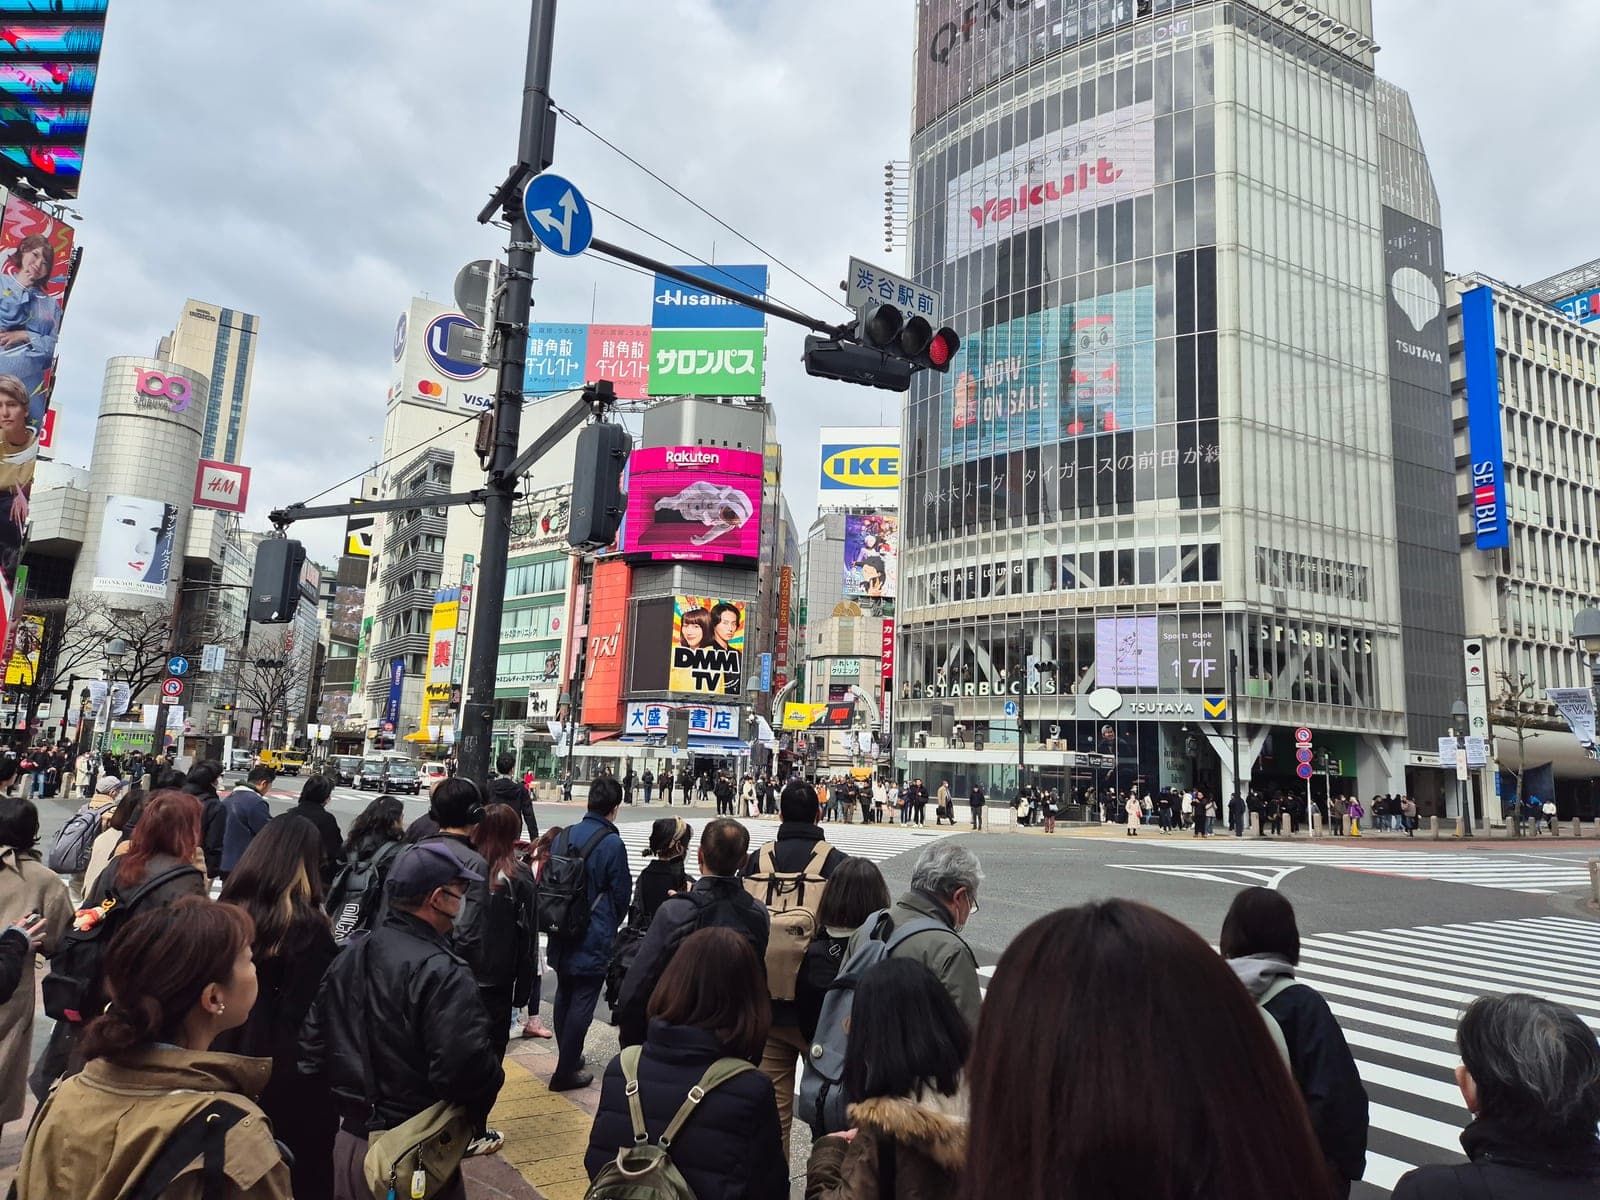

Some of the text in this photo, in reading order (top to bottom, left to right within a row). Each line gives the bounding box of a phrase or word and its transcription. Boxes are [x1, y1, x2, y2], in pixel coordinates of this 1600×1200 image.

[970, 157, 1123, 230] Yakult
[655, 290, 768, 306] Hisam
[856, 268, 934, 316] 渋谷駅前
[530, 339, 573, 357] 龍角散
[602, 340, 645, 359] 龍角散
[1396, 339, 1443, 365] TSUTAYA
[524, 357, 579, 377] ダイレクト
[595, 359, 650, 378] ダイレクト
[656, 348, 755, 375] サロンパス
[984, 355, 1021, 388] NOW
[134, 368, 192, 412] 109
[463, 393, 493, 408] VISA
[983, 394, 1003, 421] ON
[1010, 381, 1049, 414] SALE
[666, 451, 719, 467] Rakuten
[833, 458, 899, 475] IKE
[207, 477, 236, 495] H&M
[1473, 461, 1497, 536] SEIBU
[1163, 631, 1212, 641] Sports Book
[1192, 639, 1212, 648] Cafe
[1260, 624, 1372, 655] STARBUCKS
[588, 623, 622, 679] クスリ
[882, 625, 893, 669] カラオケ
[674, 647, 739, 673] DMM
[1188, 658, 1217, 678] 7F
[831, 667, 860, 675] クリニック
[692, 671, 721, 692] TV
[926, 680, 1056, 697] STARBUCKS
[1130, 702, 1194, 714] TSUTAYA
[631, 707, 732, 730] 大盛書店
